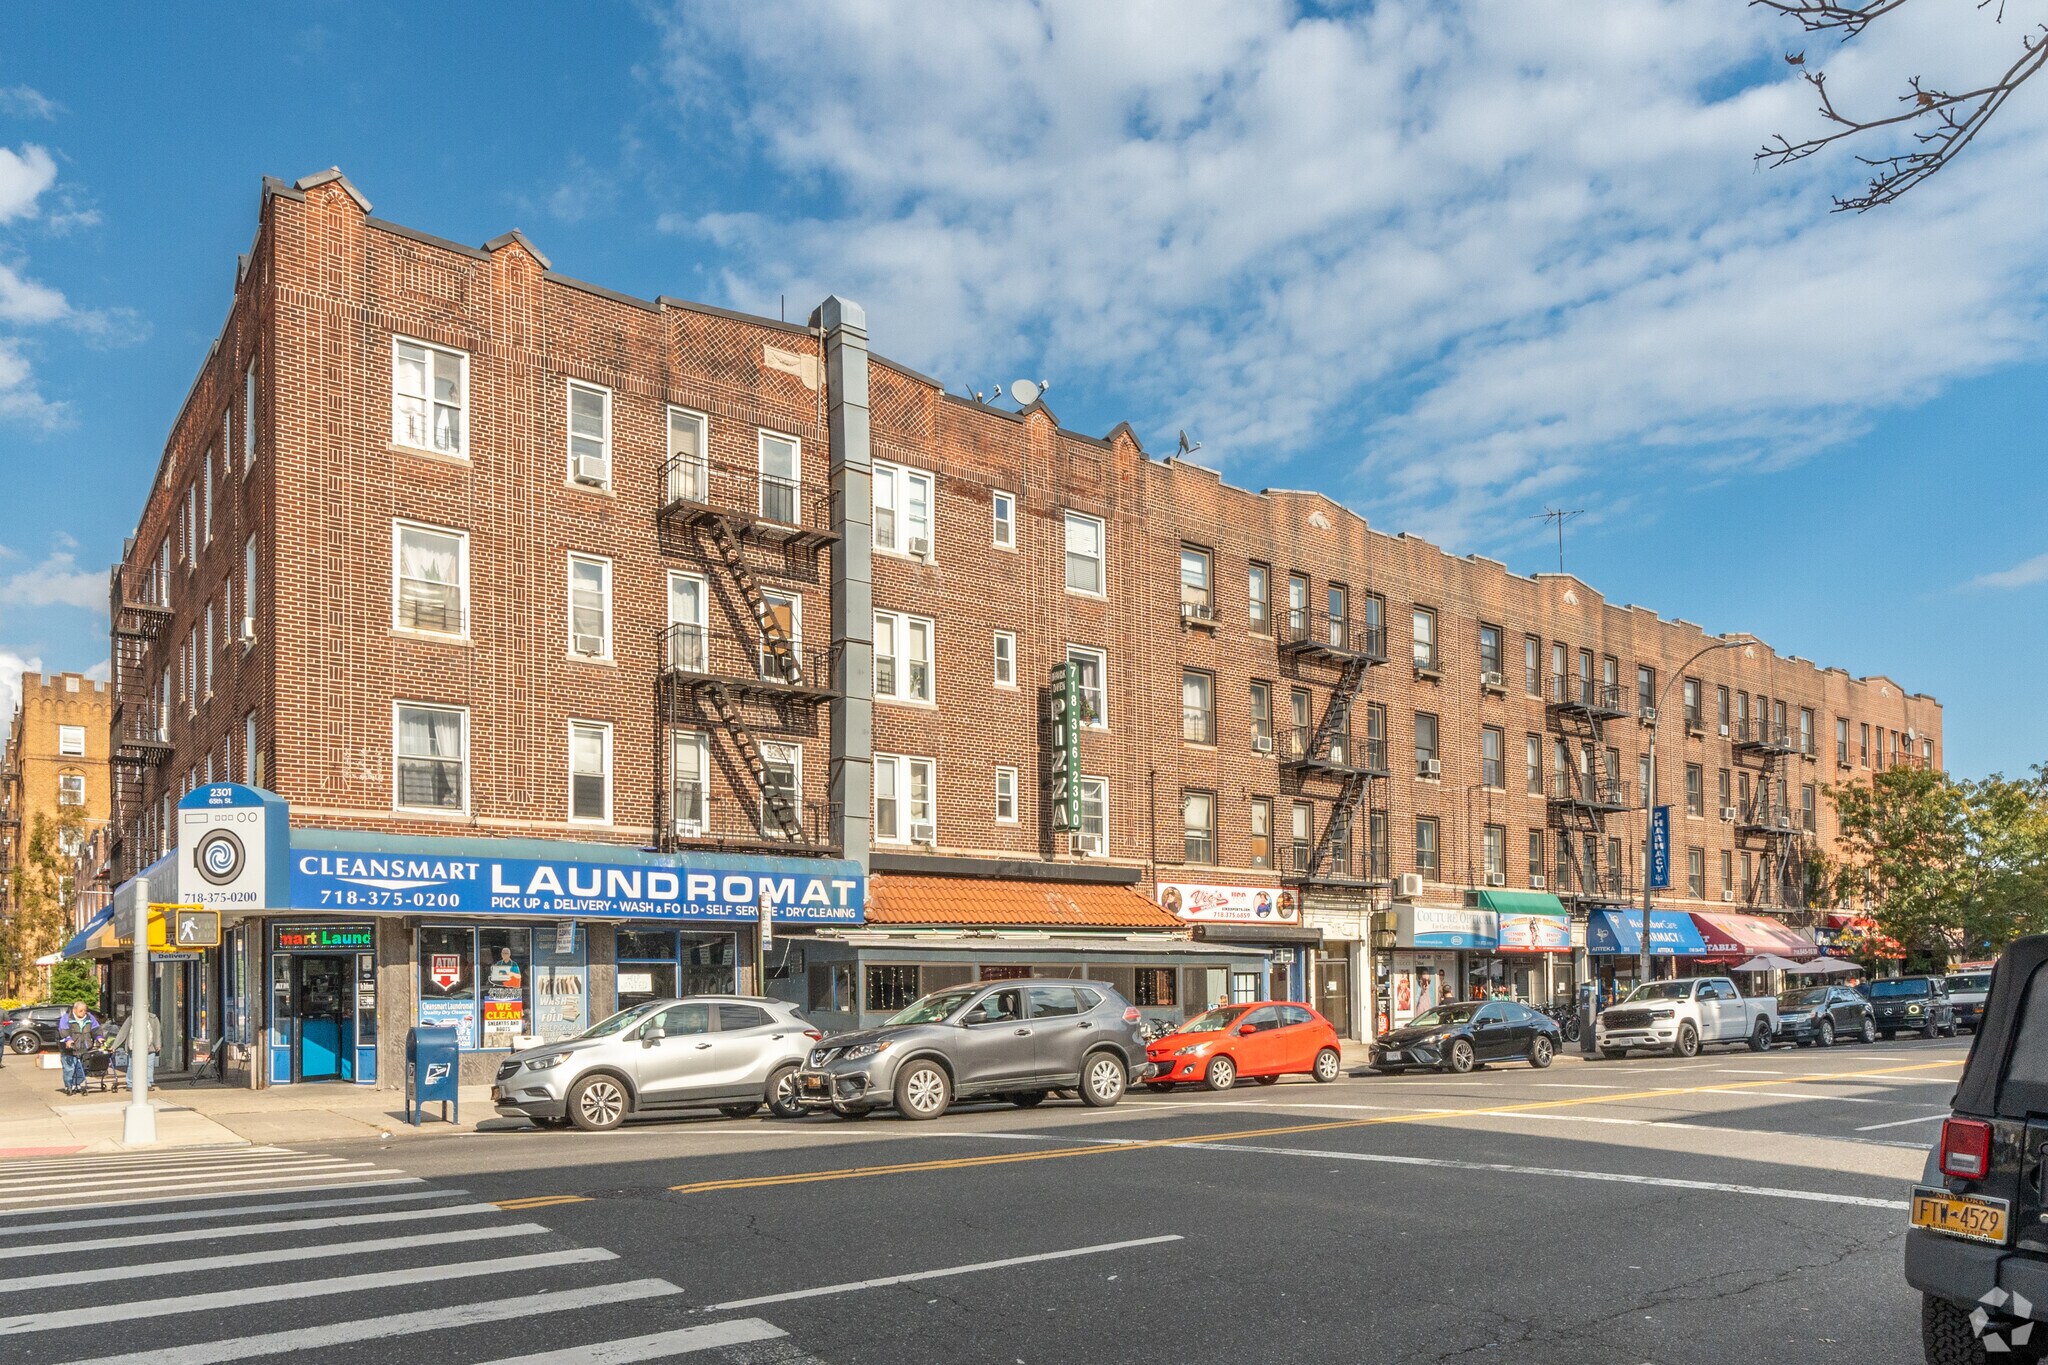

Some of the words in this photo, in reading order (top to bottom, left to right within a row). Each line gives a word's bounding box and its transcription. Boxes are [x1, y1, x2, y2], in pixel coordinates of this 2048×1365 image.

[1052, 681, 1066, 693] OVEN
[1051, 698, 1069, 827] PIZZA
[210, 787, 232, 797] 2301
[1653, 811, 1665, 873] PHARMACY
[299, 855, 480, 880] CLEANSMART
[491, 863, 856, 906] LAUNDROMAT
[184, 891, 258, 905] 718-375-0200
[320, 889, 460, 907] 718-375-0200
[491, 896, 520, 909] PICK
[524, 897, 541, 910] UP
[543, 902, 550, 910] &
[554, 898, 612, 912] DELIVERY
[619, 901, 654, 913] WASH
[656, 905, 662, 914] &
[706, 904, 732, 916] SELF
[735, 905, 778, 917] SERVE
[785, 906, 806, 918] DRY
[807, 907, 855, 919] CLEANING
[1417, 910, 1457, 923] COUTURE
[1459, 911, 1494, 926] OPTICAL
[1629, 919, 1678, 929] NeiborCare
[1635, 932, 1679, 942] PARMACY
[436, 957, 456, 968] ATM
[495, 1002, 512, 1011] WE
[540, 996, 567, 1006] WASH
[486, 1011, 521, 1020] CLEAN
[541, 1013, 563, 1022] FOLD
[1936, 1191, 1957, 1201] NEW
[1961, 1195, 1986, 1206] YORK
